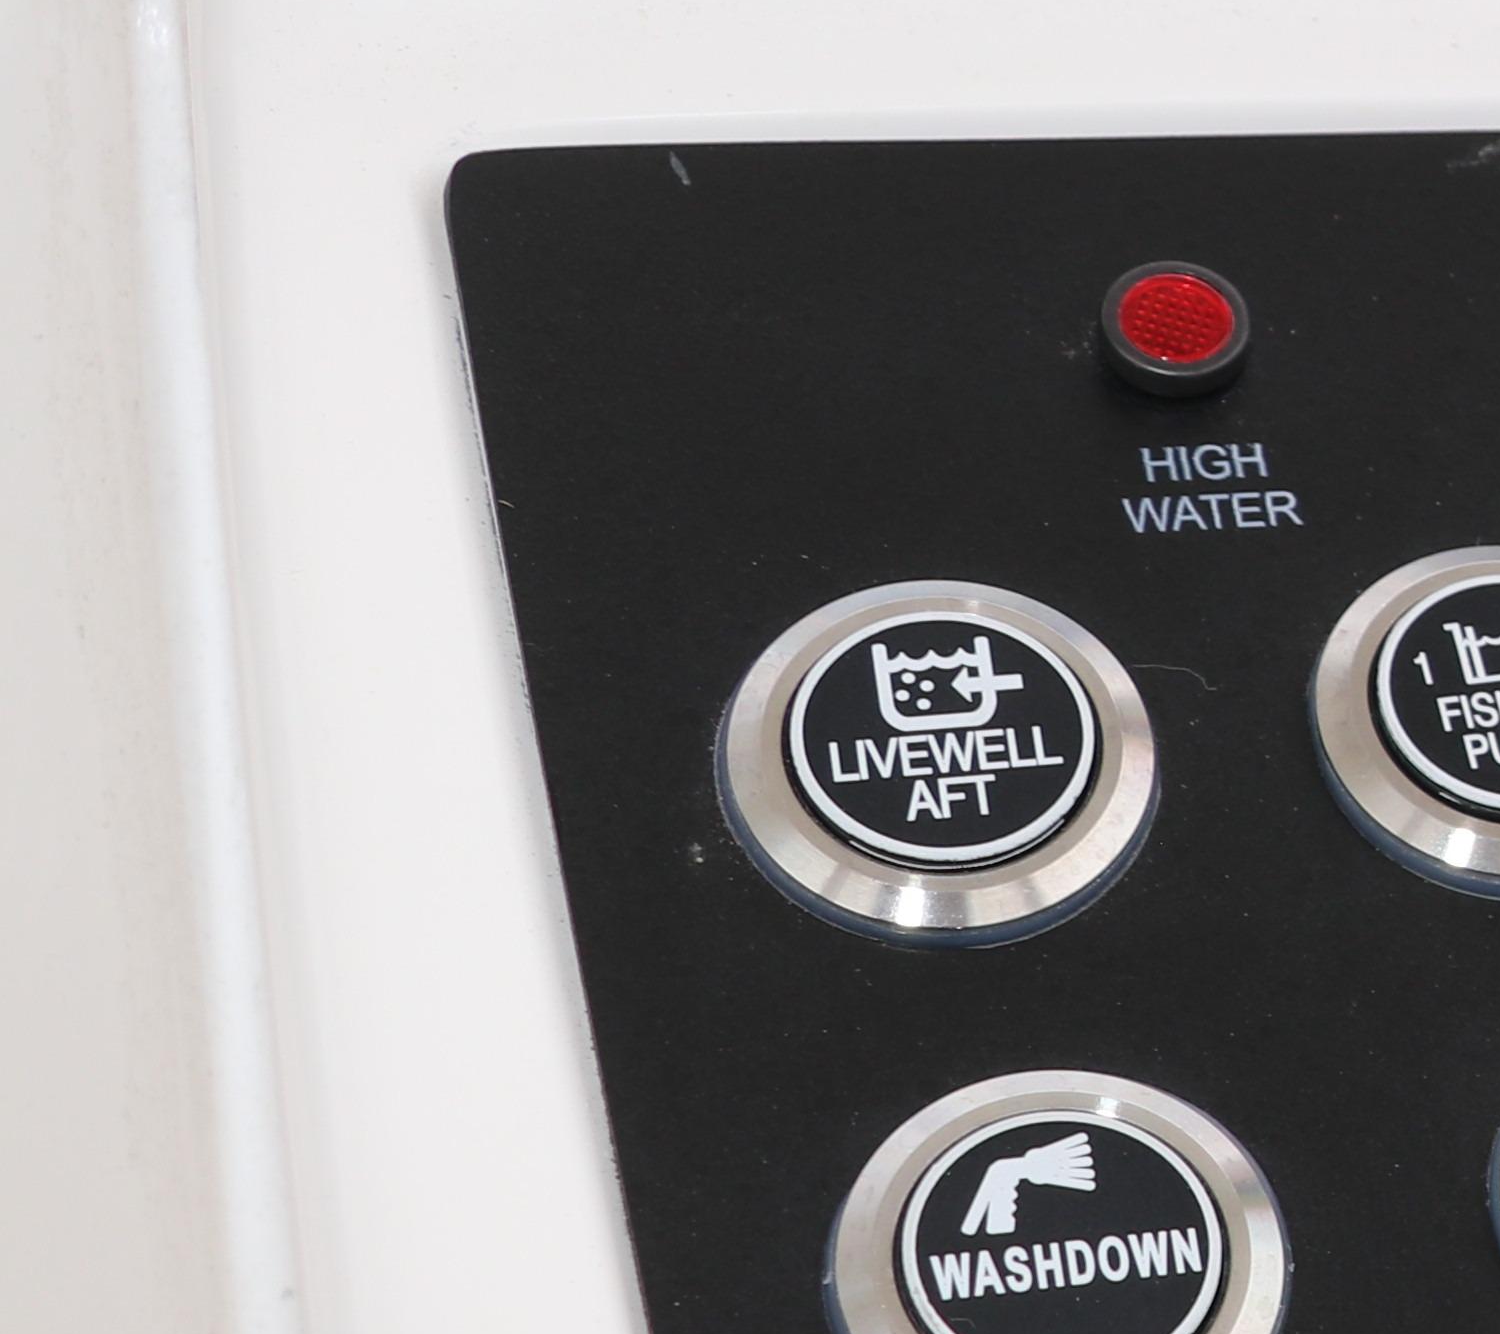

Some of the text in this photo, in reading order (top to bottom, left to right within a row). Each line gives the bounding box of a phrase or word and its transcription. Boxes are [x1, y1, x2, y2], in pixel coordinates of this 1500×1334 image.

[1138, 442, 1270, 484] HIGH
[1121, 490, 1305, 534] WATER
[1412, 651, 1435, 686] 1
[827, 724, 1066, 784] LIVEWELL
[905, 773, 997, 822] AFT
[928, 1226, 1203, 1302] WASHDOWN
